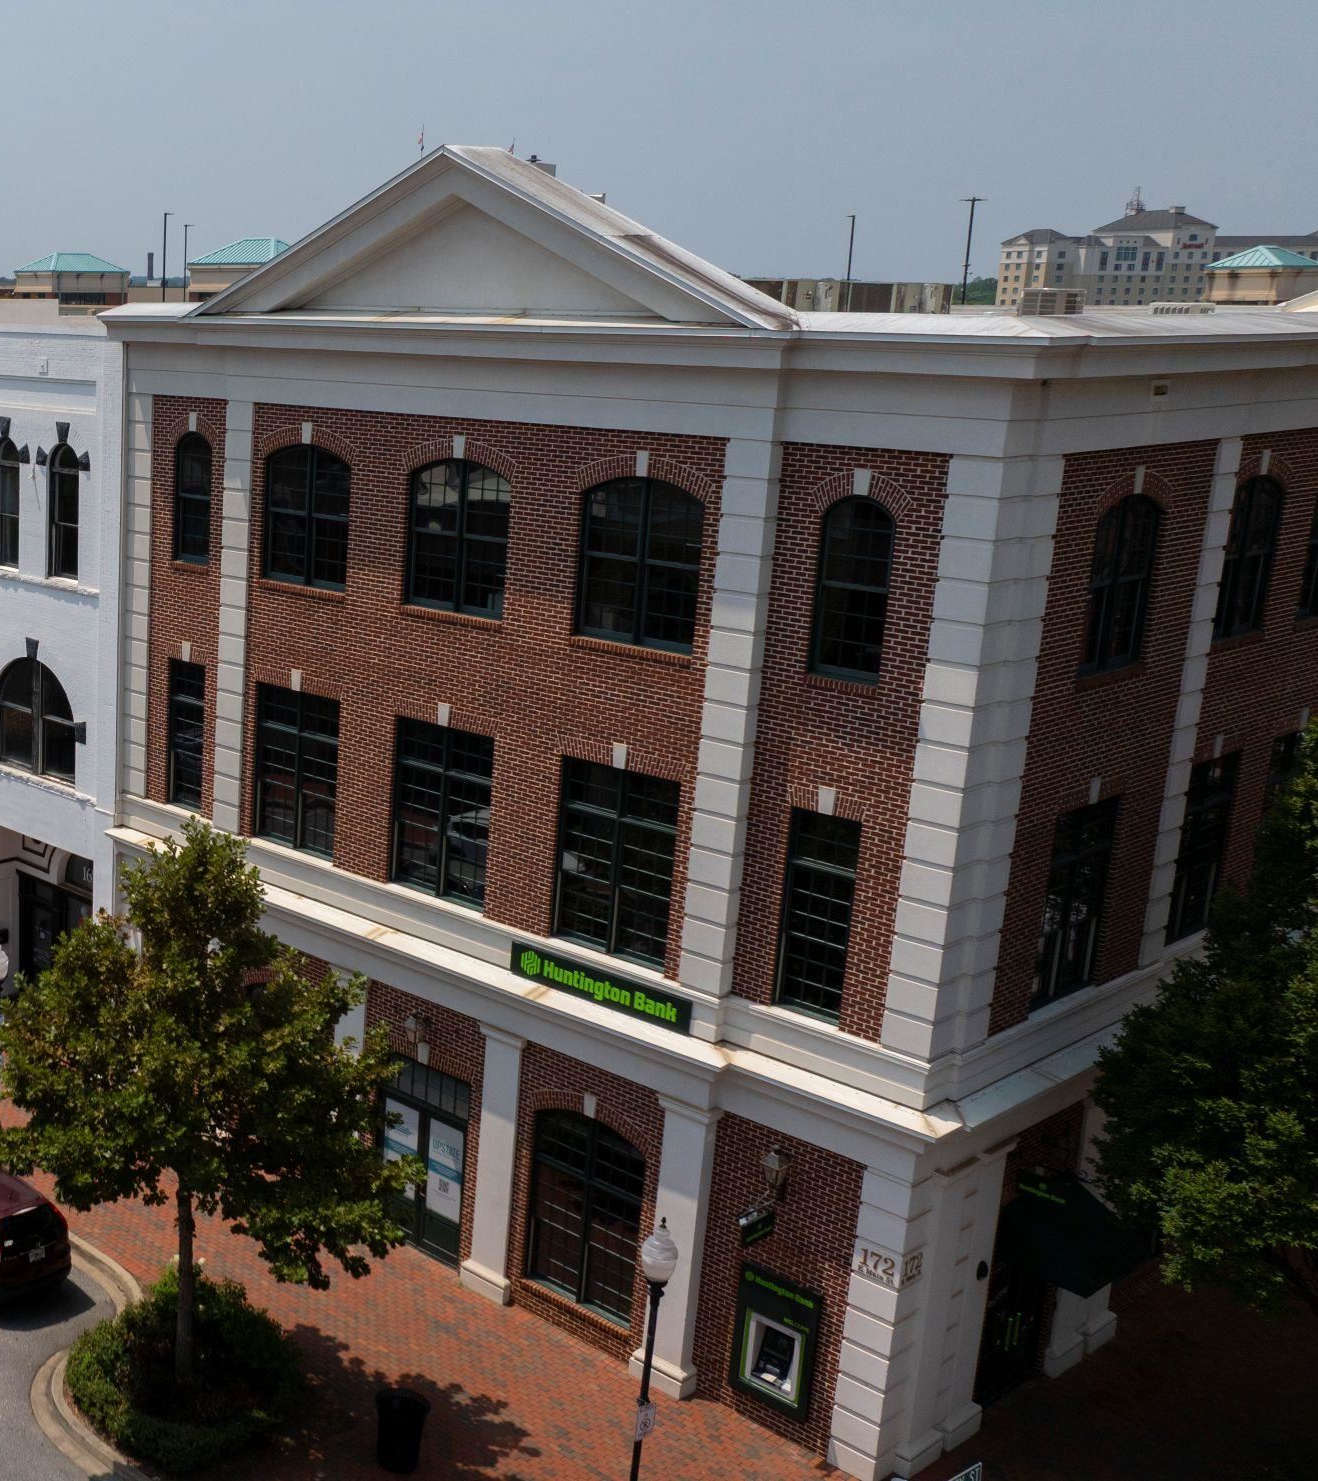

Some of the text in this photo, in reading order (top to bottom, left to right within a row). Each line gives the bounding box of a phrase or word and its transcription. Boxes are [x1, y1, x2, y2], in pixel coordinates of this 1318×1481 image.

[82, 866, 93, 882] 16
[543, 959, 677, 1023] Huntington Bank
[433, 1138, 459, 1160] UPSTATE
[860, 1248, 895, 1277] 172
[904, 1252, 922, 1278] 172
[755, 1275, 814, 1309] Huntington Bank
